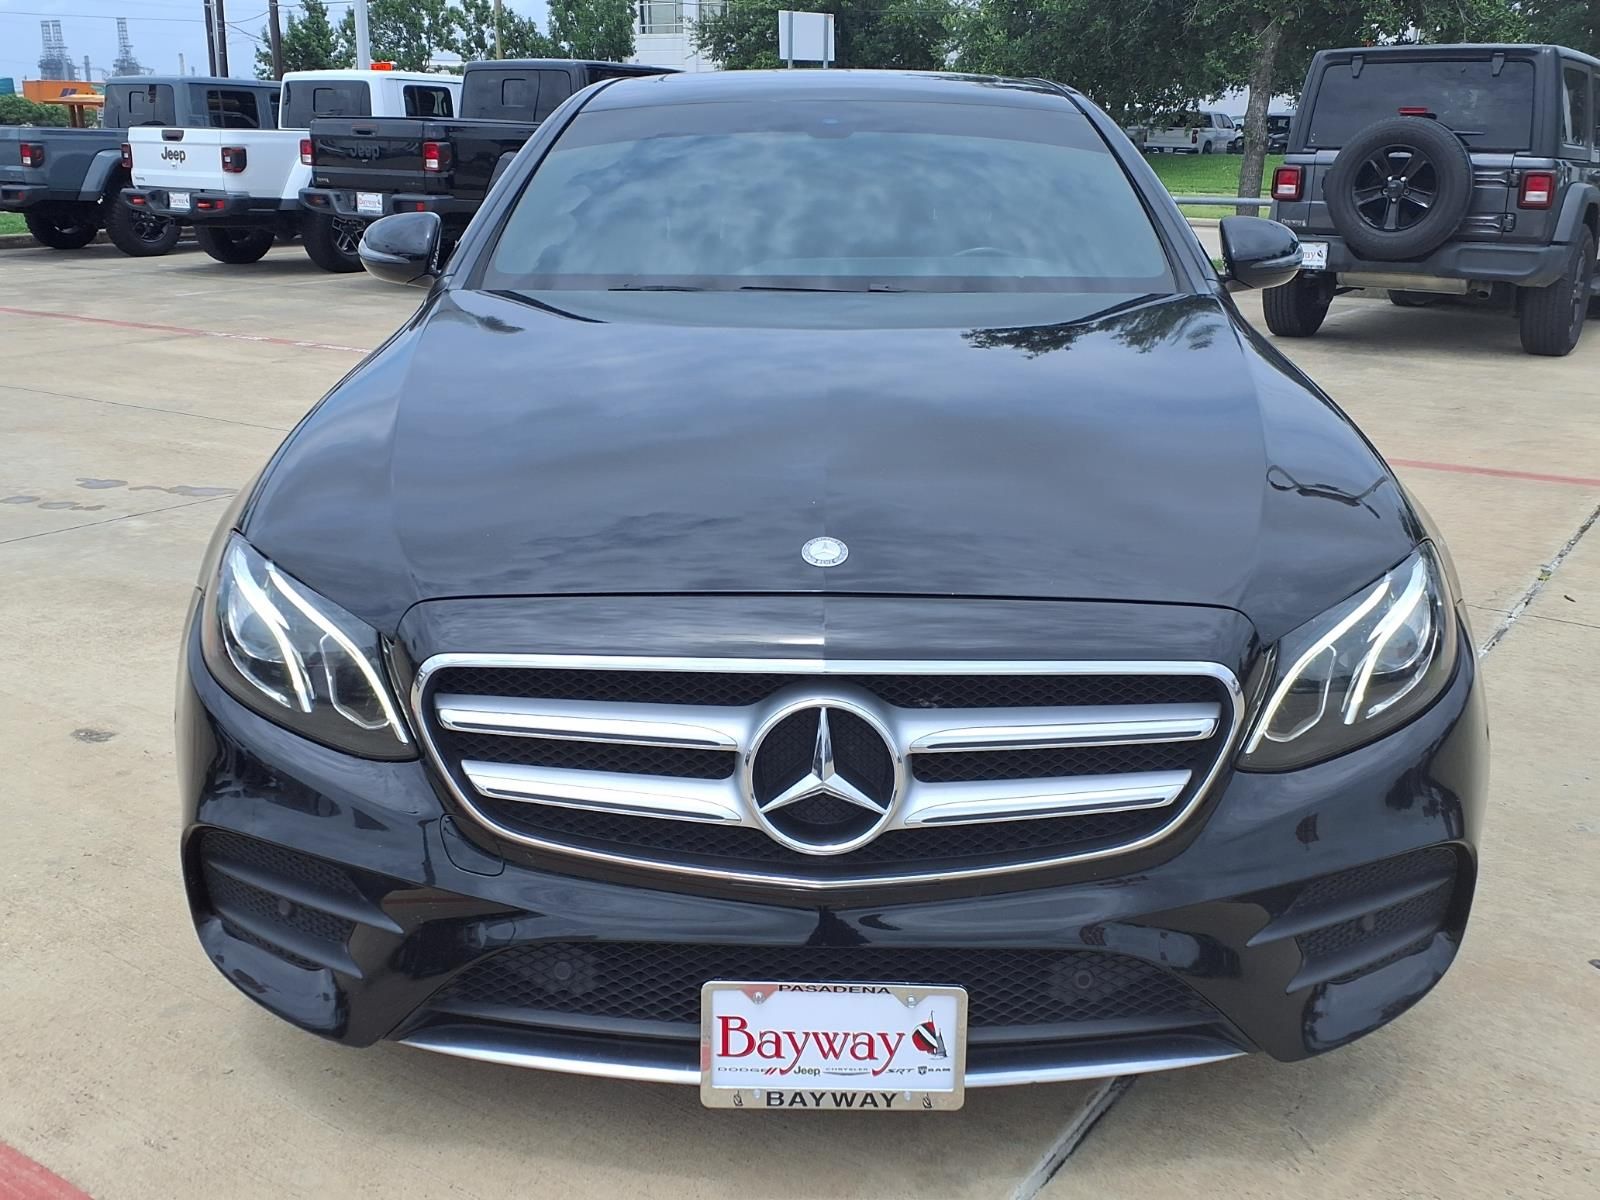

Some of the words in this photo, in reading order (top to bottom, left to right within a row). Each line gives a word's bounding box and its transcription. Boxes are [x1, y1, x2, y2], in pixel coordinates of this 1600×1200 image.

[161, 146, 186, 163] Jeep
[351, 142, 380, 160] Jeep
[777, 984, 892, 995] PASADENA
[716, 1015, 905, 1077] Bayway
[793, 1065, 821, 1077] Jeep
[766, 1091, 898, 1108] BAYWAY
